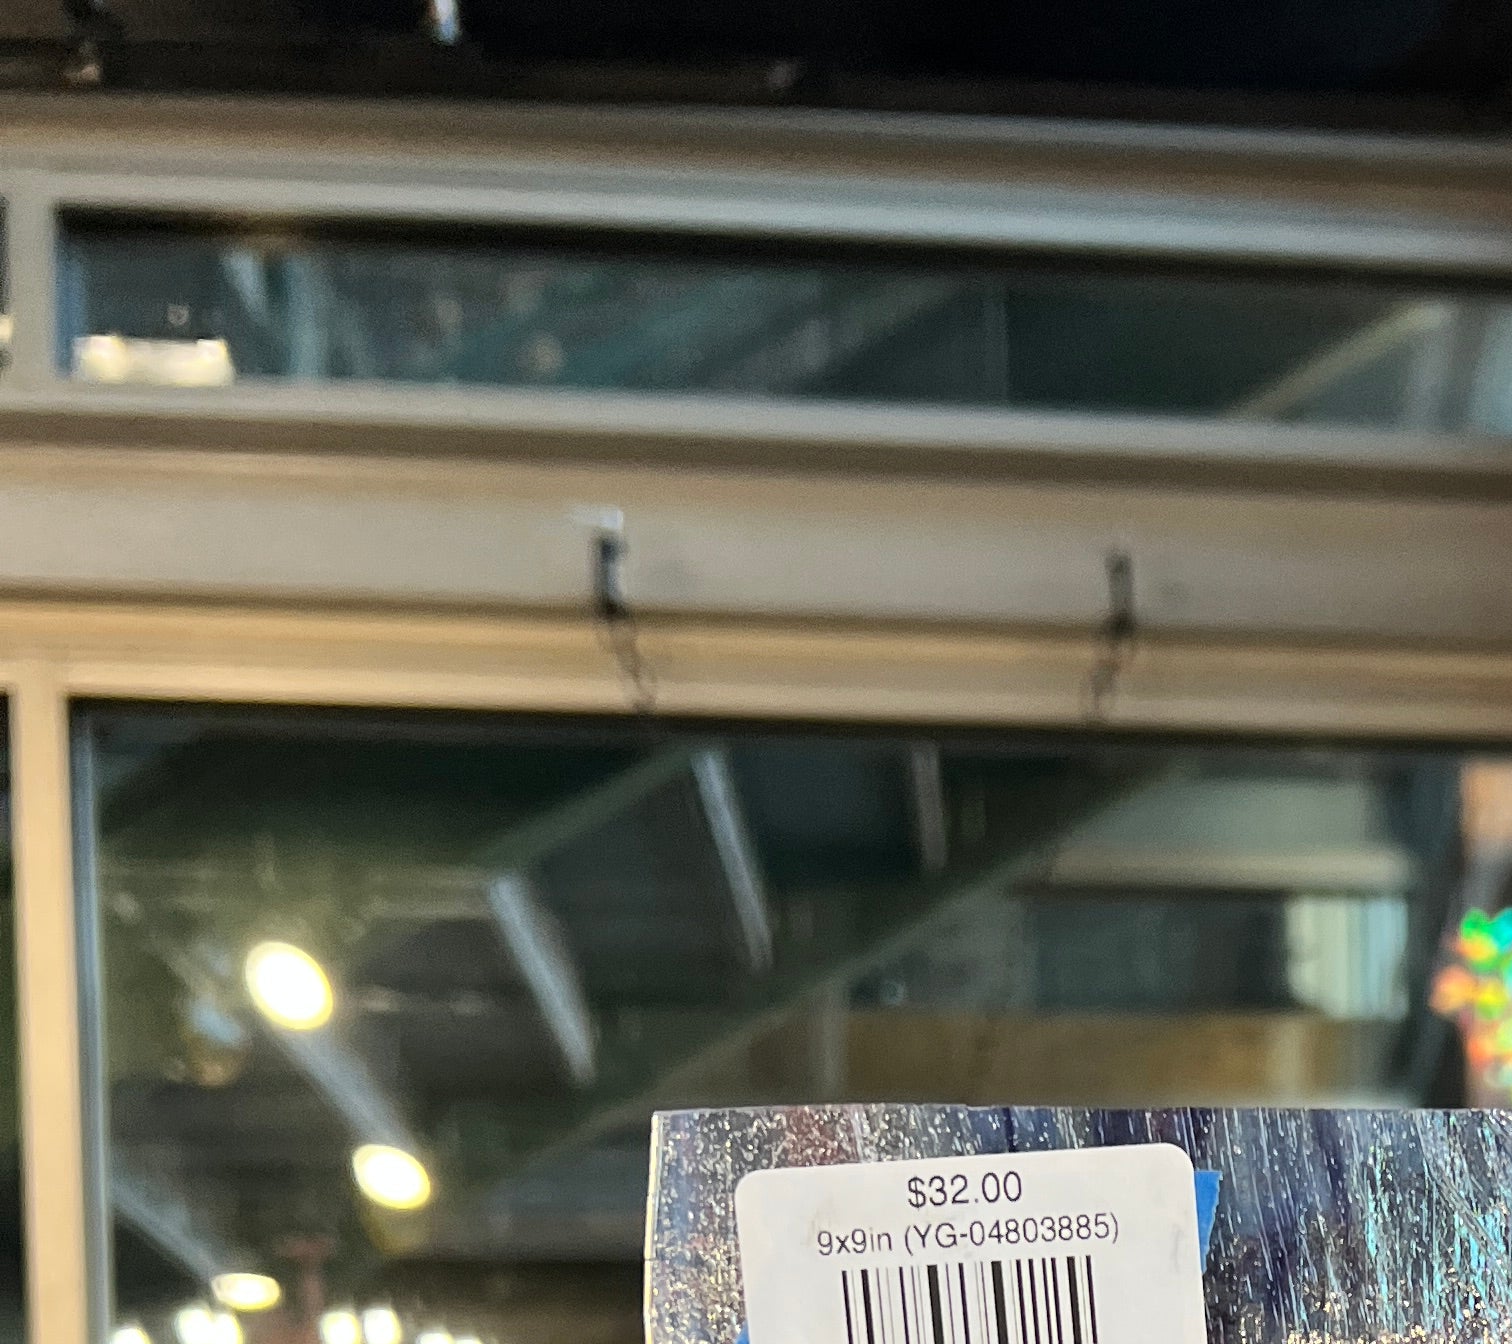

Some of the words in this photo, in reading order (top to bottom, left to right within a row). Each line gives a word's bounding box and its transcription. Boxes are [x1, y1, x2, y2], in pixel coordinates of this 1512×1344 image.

[908, 1171, 1022, 1209] $32.00
[817, 1229, 893, 1256] 9x9in
[904, 1212, 1119, 1256] (YG-04803885)
